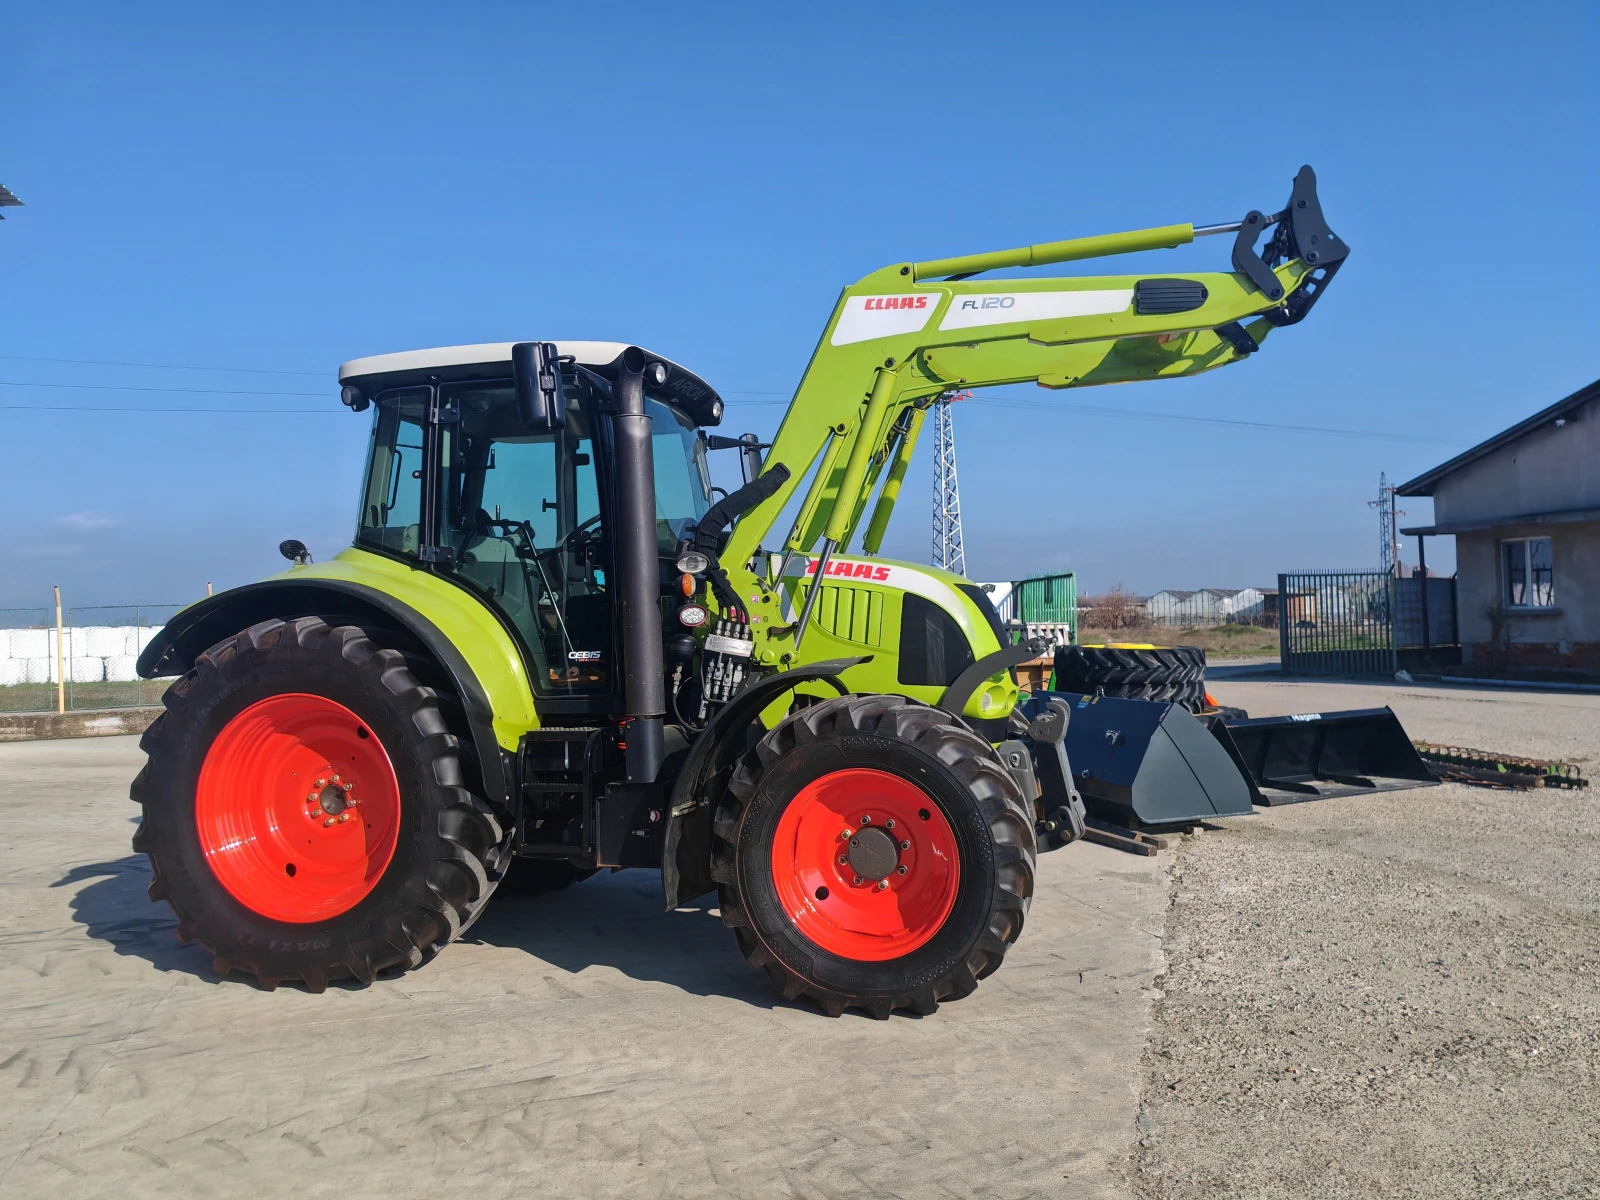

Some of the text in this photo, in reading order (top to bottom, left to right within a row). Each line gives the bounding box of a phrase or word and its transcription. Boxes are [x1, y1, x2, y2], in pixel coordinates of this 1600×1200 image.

[864, 296, 928, 311] CLAAS
[669, 378, 706, 401] ARION
[568, 650, 602, 660] CEBIS
